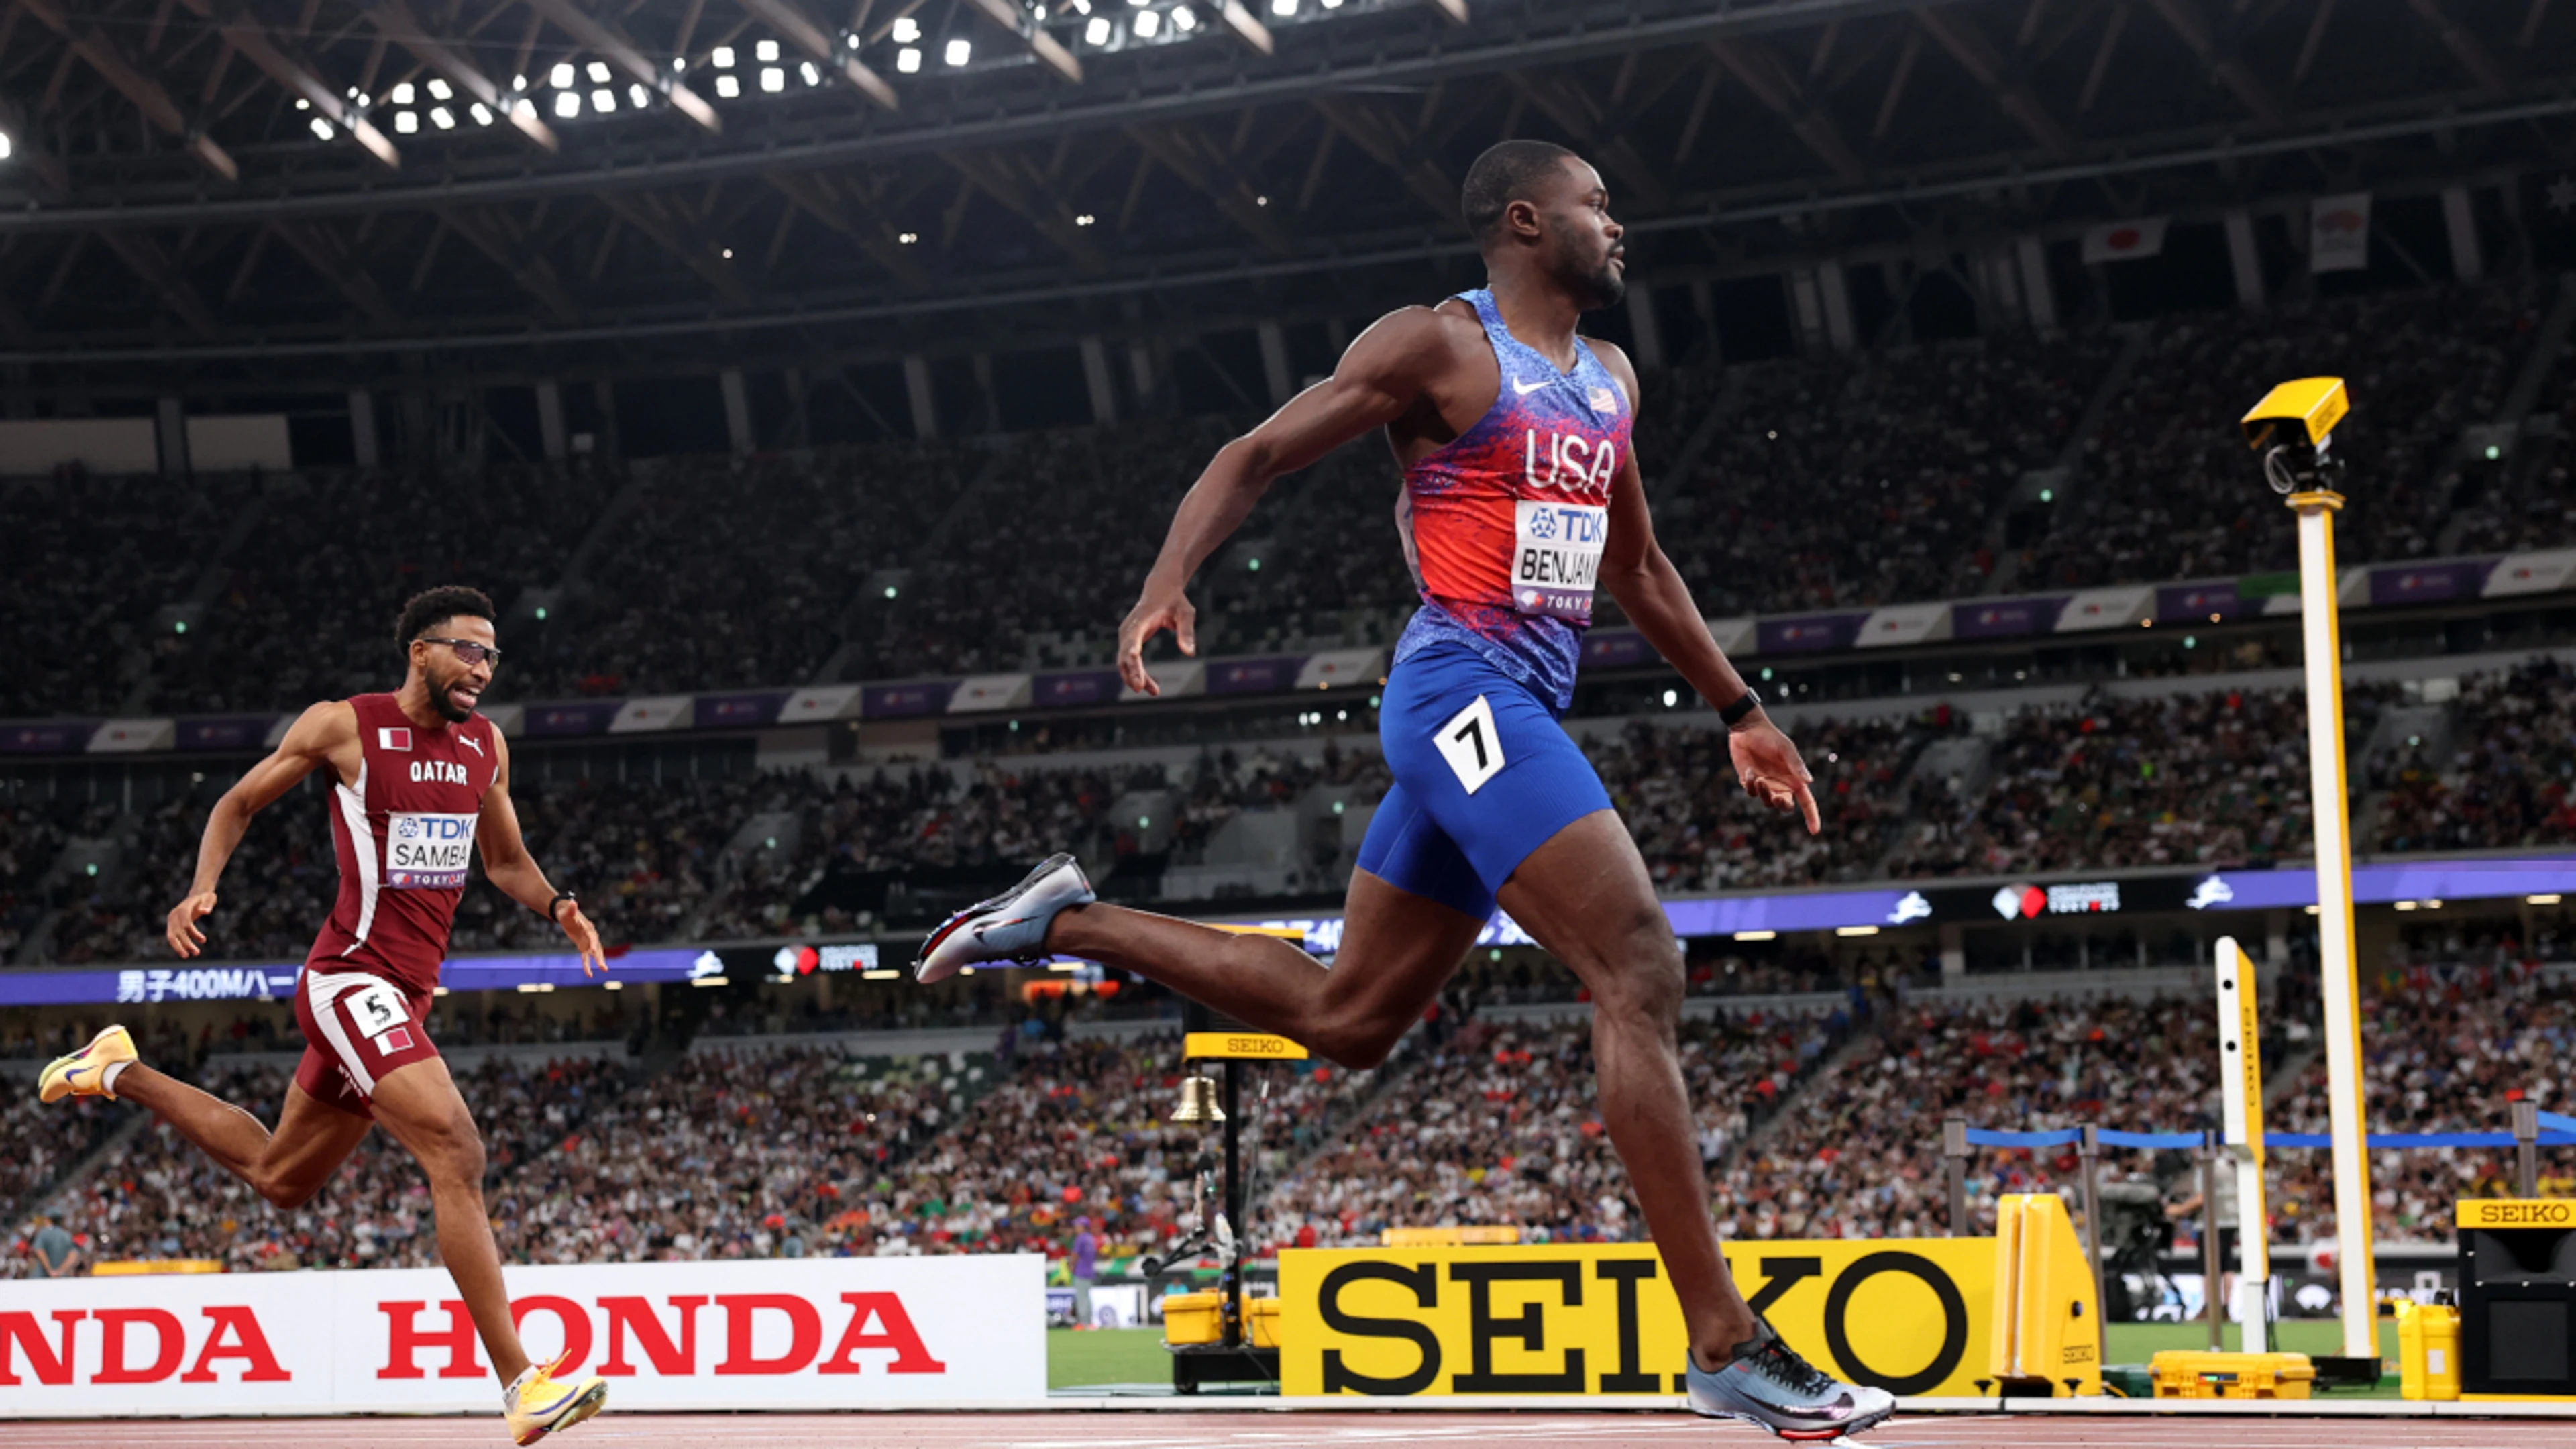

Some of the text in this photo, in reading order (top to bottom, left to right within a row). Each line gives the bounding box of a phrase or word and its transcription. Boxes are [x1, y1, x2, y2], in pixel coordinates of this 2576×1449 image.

[1526, 429, 1615, 498] USA
[1558, 508, 1603, 543] TDK
[1454, 716, 1489, 771] 7
[409, 761, 468, 786] QATAR
[420, 817, 472, 840] TDK
[394, 843, 467, 867] SAMBA
[365, 993, 392, 1026] 5
[1227, 1038, 1284, 1054] SEIKO
[2481, 1203, 2570, 1223] SEIKO
[376, 1291, 947, 1379] HONDA
